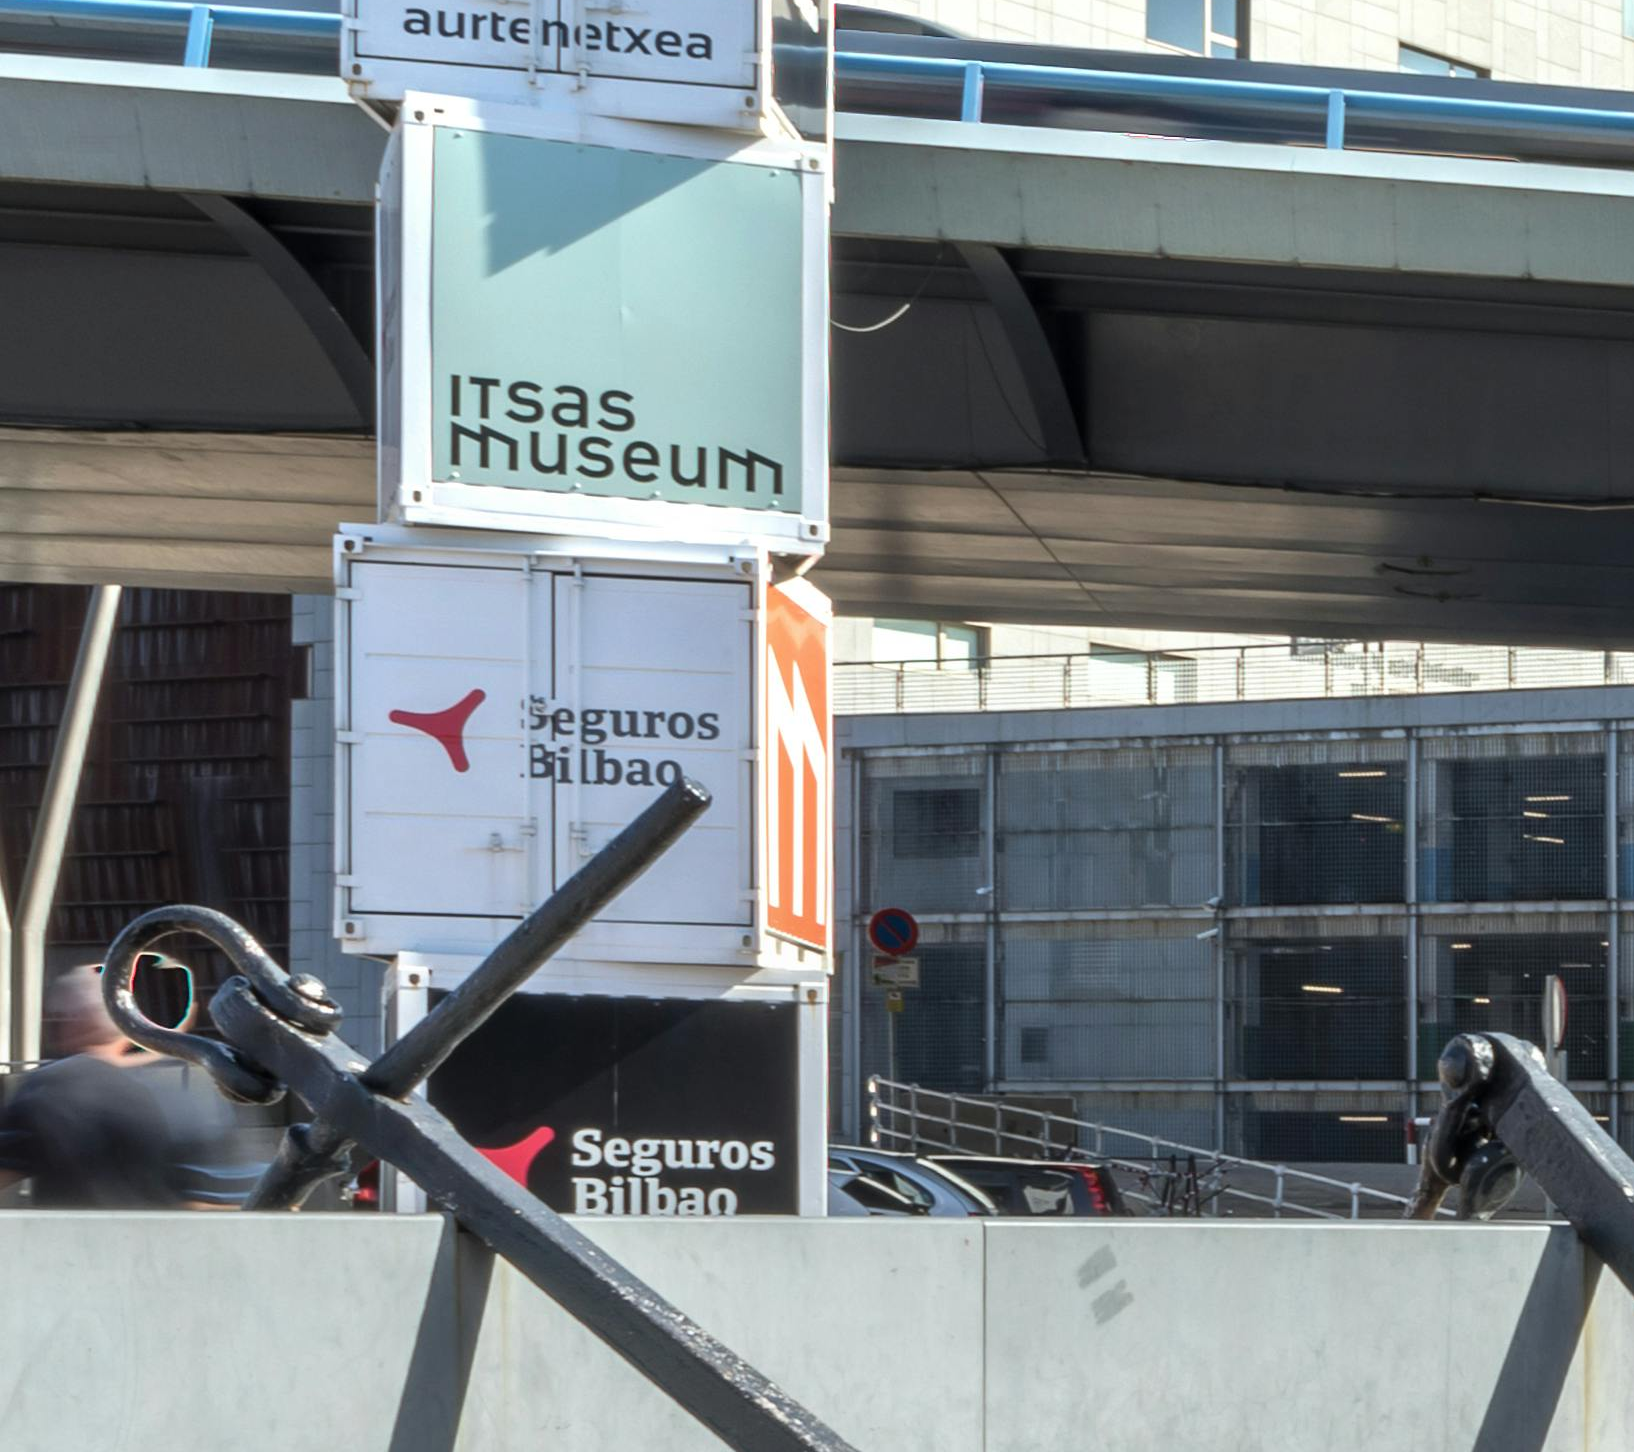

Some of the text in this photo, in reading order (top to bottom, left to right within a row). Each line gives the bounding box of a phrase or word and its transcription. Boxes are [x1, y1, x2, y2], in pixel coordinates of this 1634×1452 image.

[402, 7, 714, 62] aurtenetxea
[450, 421, 783, 495] museum
[519, 694, 720, 745] Seguros
[519, 742, 684, 787] Bilbao
[571, 1128, 776, 1177] Seguros
[571, 1176, 738, 1216] Bilbao
